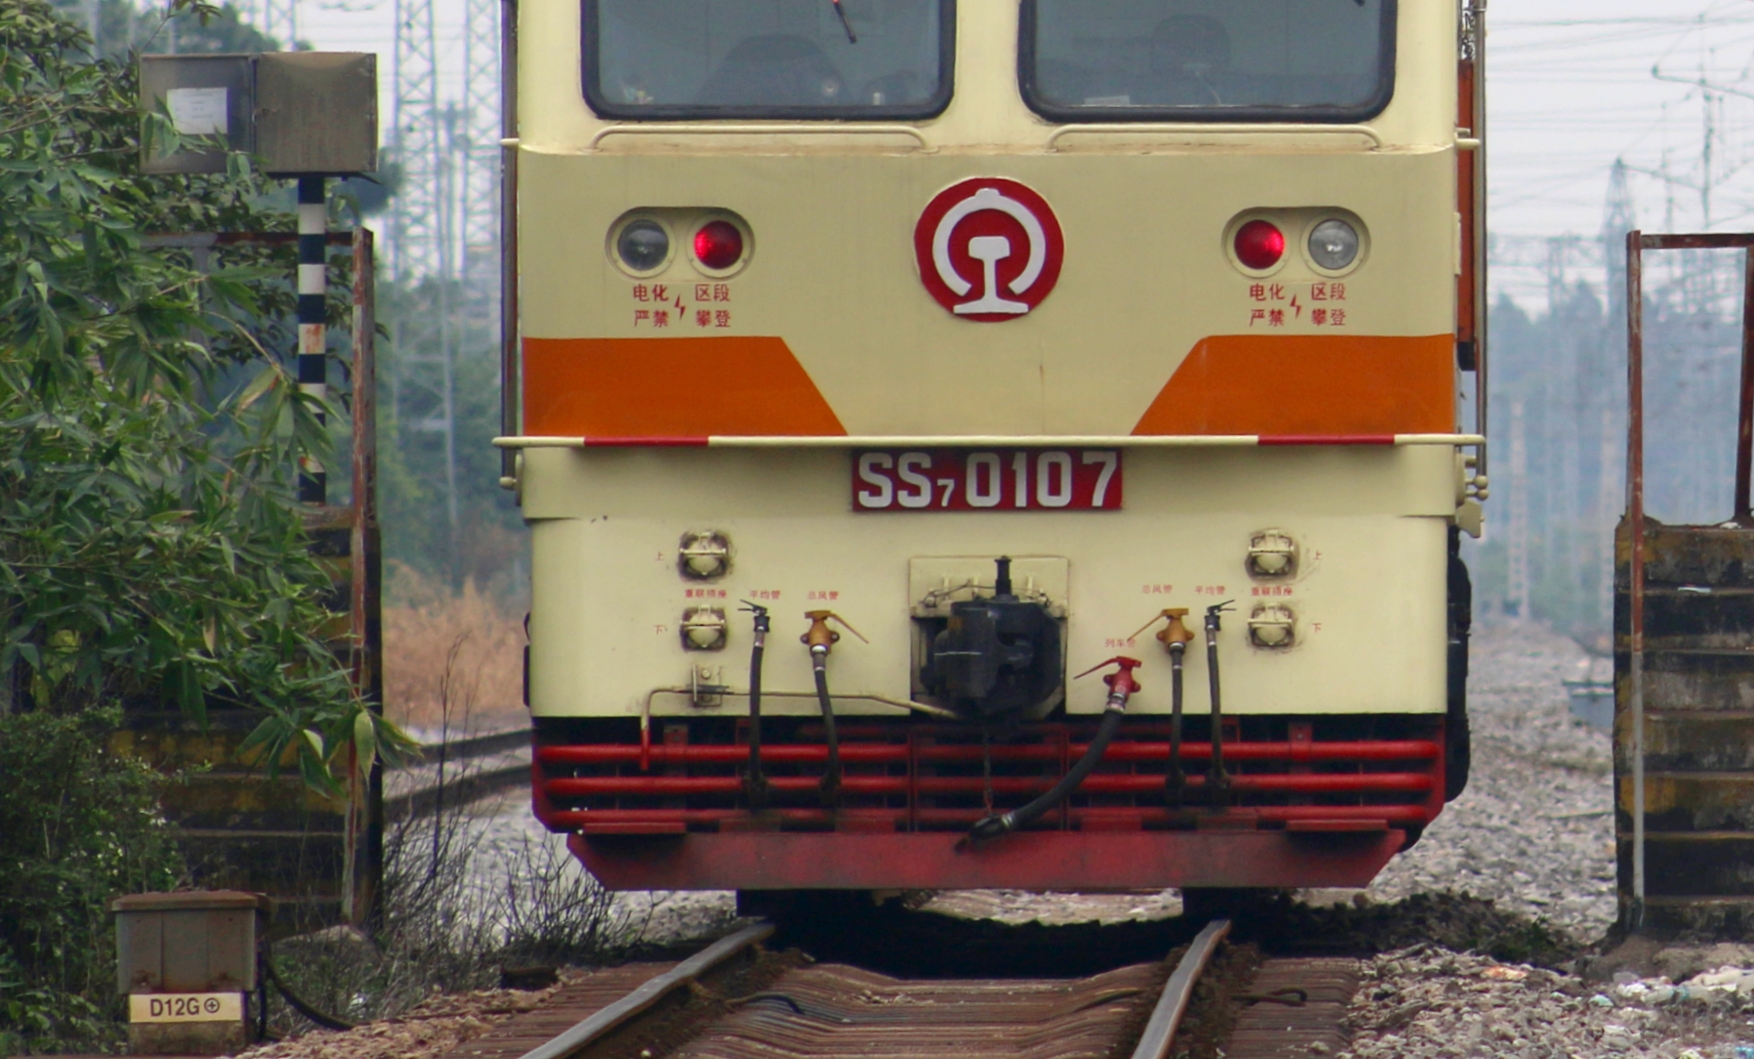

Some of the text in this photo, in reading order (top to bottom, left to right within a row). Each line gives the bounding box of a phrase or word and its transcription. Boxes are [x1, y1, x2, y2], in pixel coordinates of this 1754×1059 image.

[633, 283, 730, 302] 电化 区段
[1249, 282, 1346, 302] 电化 区段
[634, 309, 731, 328] 严禁 攀登
[1249, 308, 1346, 327] 严禁 攀登
[858, 450, 1118, 508] SS70107
[150, 998, 200, 1017] D12G
